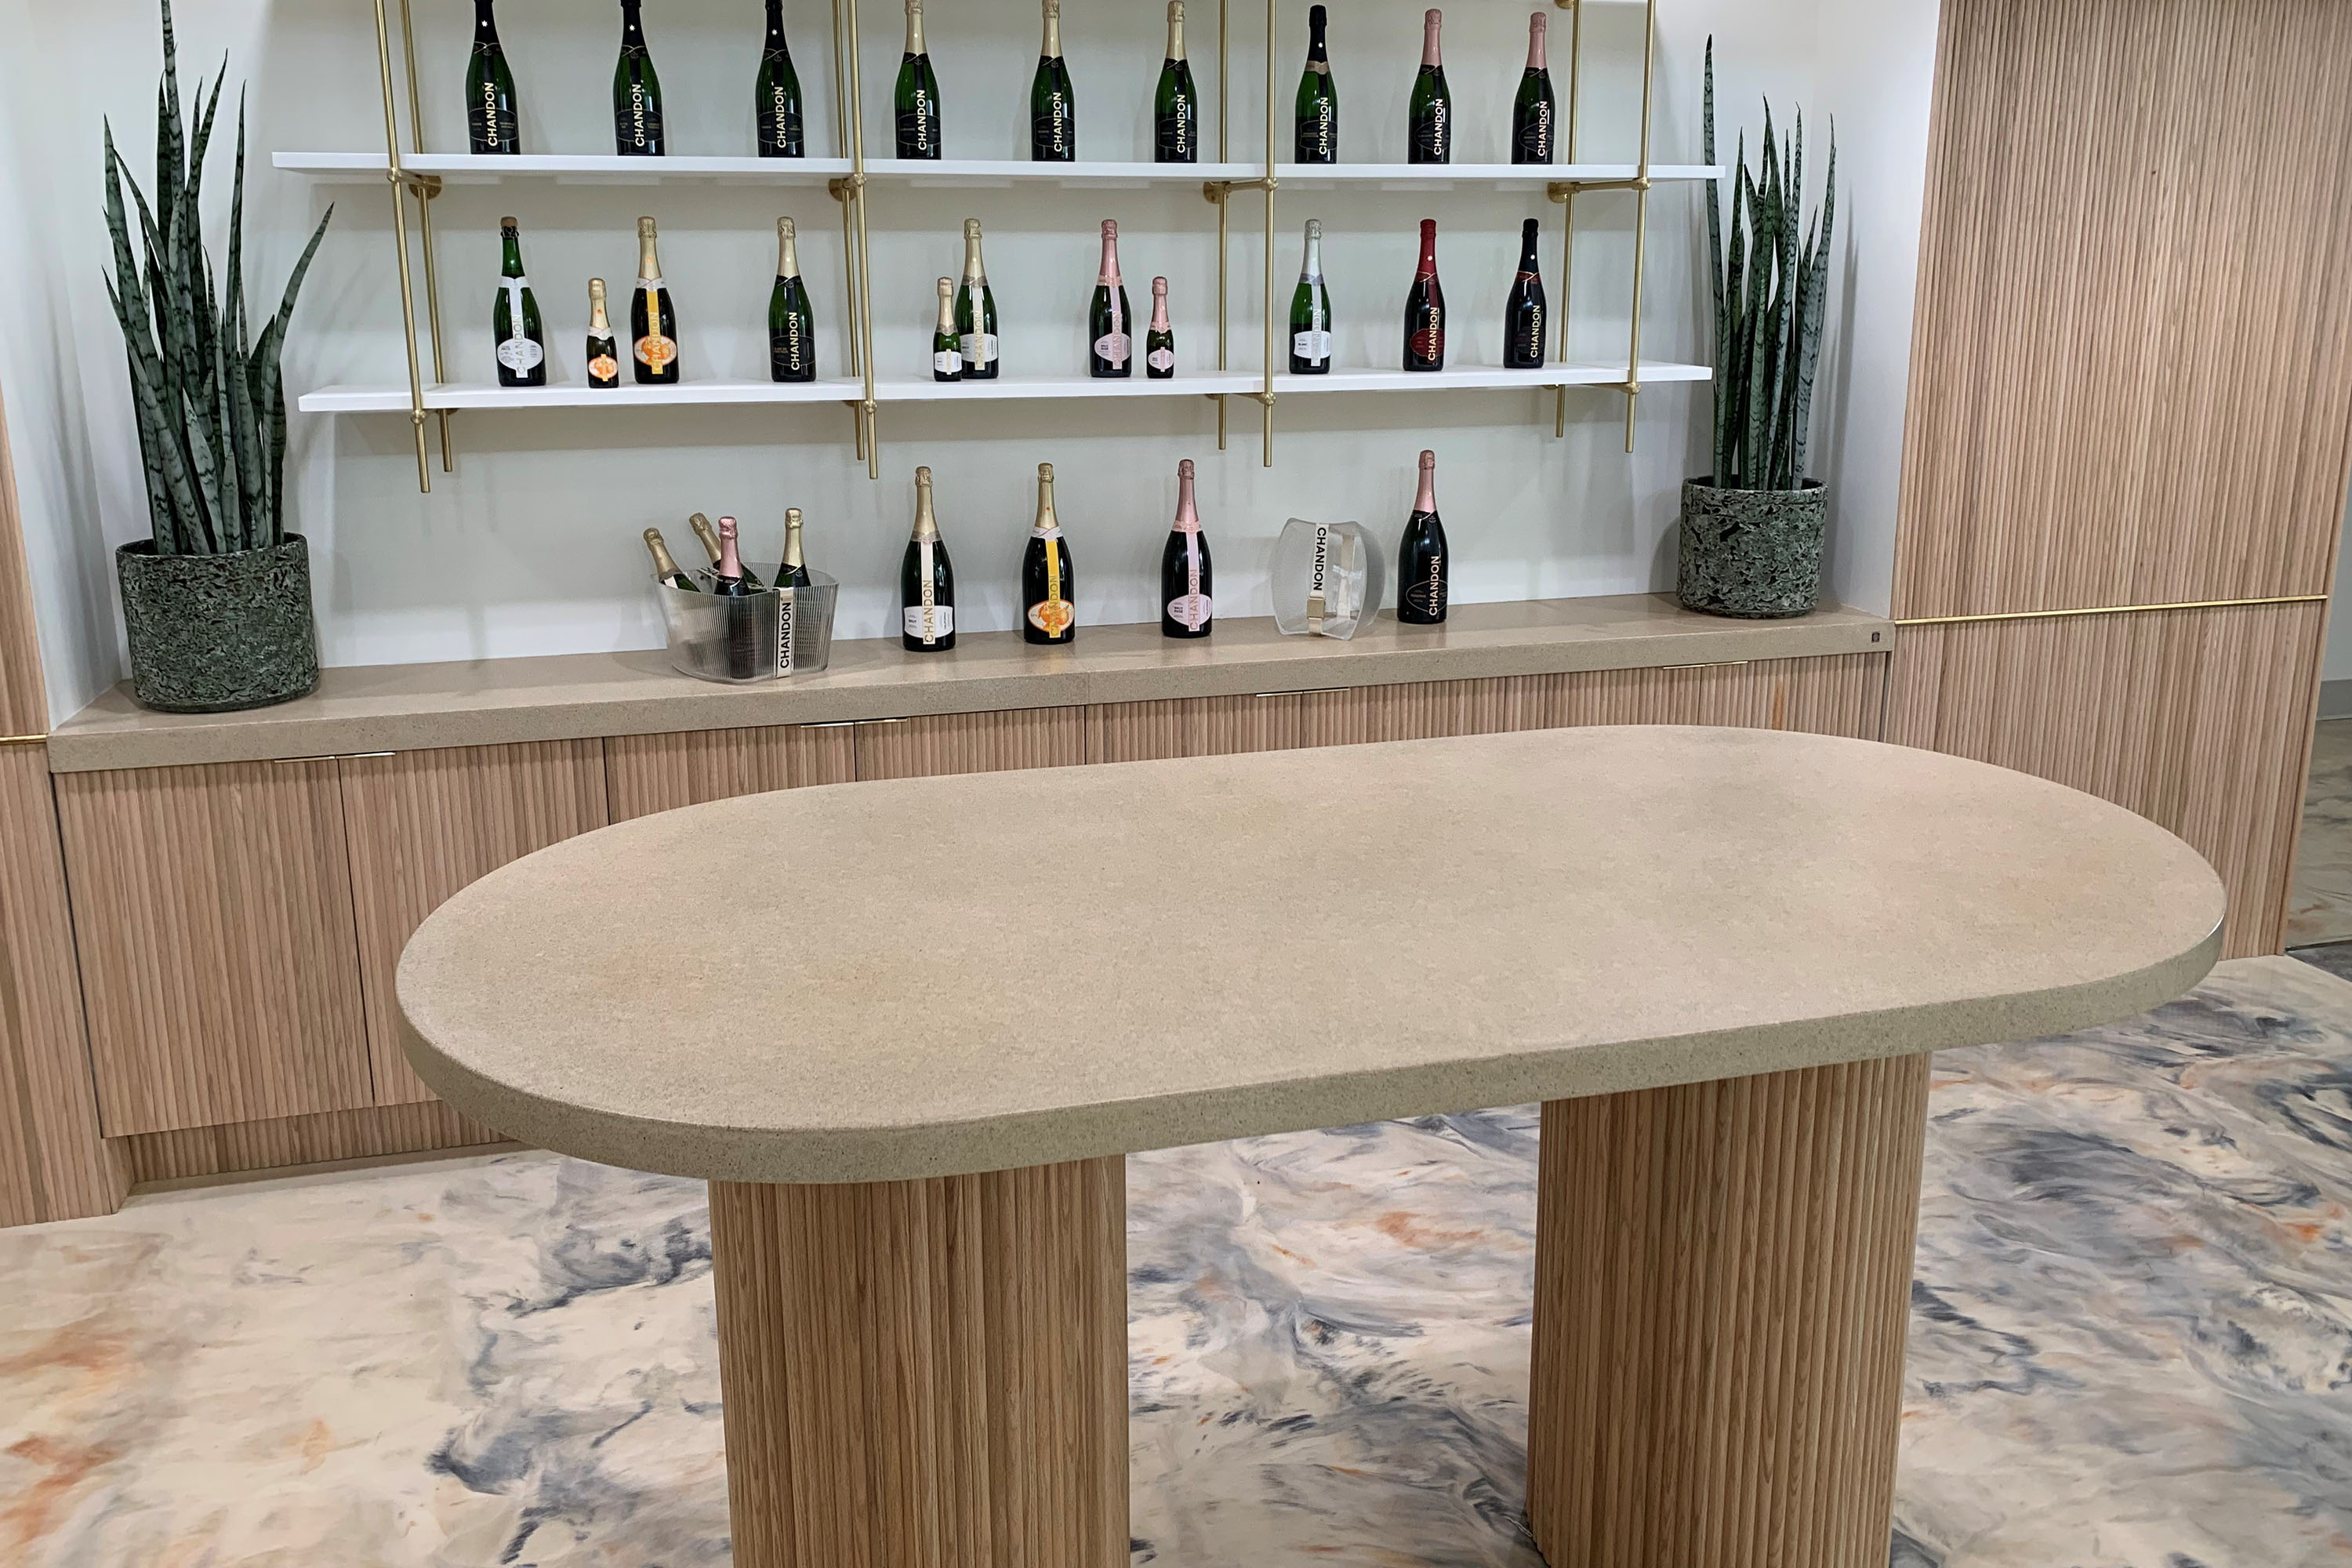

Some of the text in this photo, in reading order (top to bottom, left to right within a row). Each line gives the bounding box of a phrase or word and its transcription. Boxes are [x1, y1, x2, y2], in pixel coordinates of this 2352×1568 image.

[484, 82, 498, 147] CHANDON
[632, 84, 645, 147] CHANDON
[774, 86, 786, 148] CHANDON
[916, 89, 927, 151] CHANDON
[1053, 92, 1062, 152] CHANDON
[1176, 94, 1185, 153] CHANDON
[1319, 96, 1328, 154] CHANDON
[1433, 98, 1443, 155] CHANDON
[1537, 100, 1548, 157] CHANDON
[513, 314, 526, 374] CHANDON
[651, 312, 662, 371] CHANDON
[788, 311, 800, 371] CHANDON
[1428, 307, 1438, 361] CHANDON
[1530, 305, 1541, 358] CHANDON
[1313, 527, 1327, 590] CHANDON
[1428, 555, 1440, 616] CHANDON
[923, 579, 934, 642] CHANDON
[1189, 569, 1199, 630] CHANDON
[779, 602, 792, 668] CHANDON
